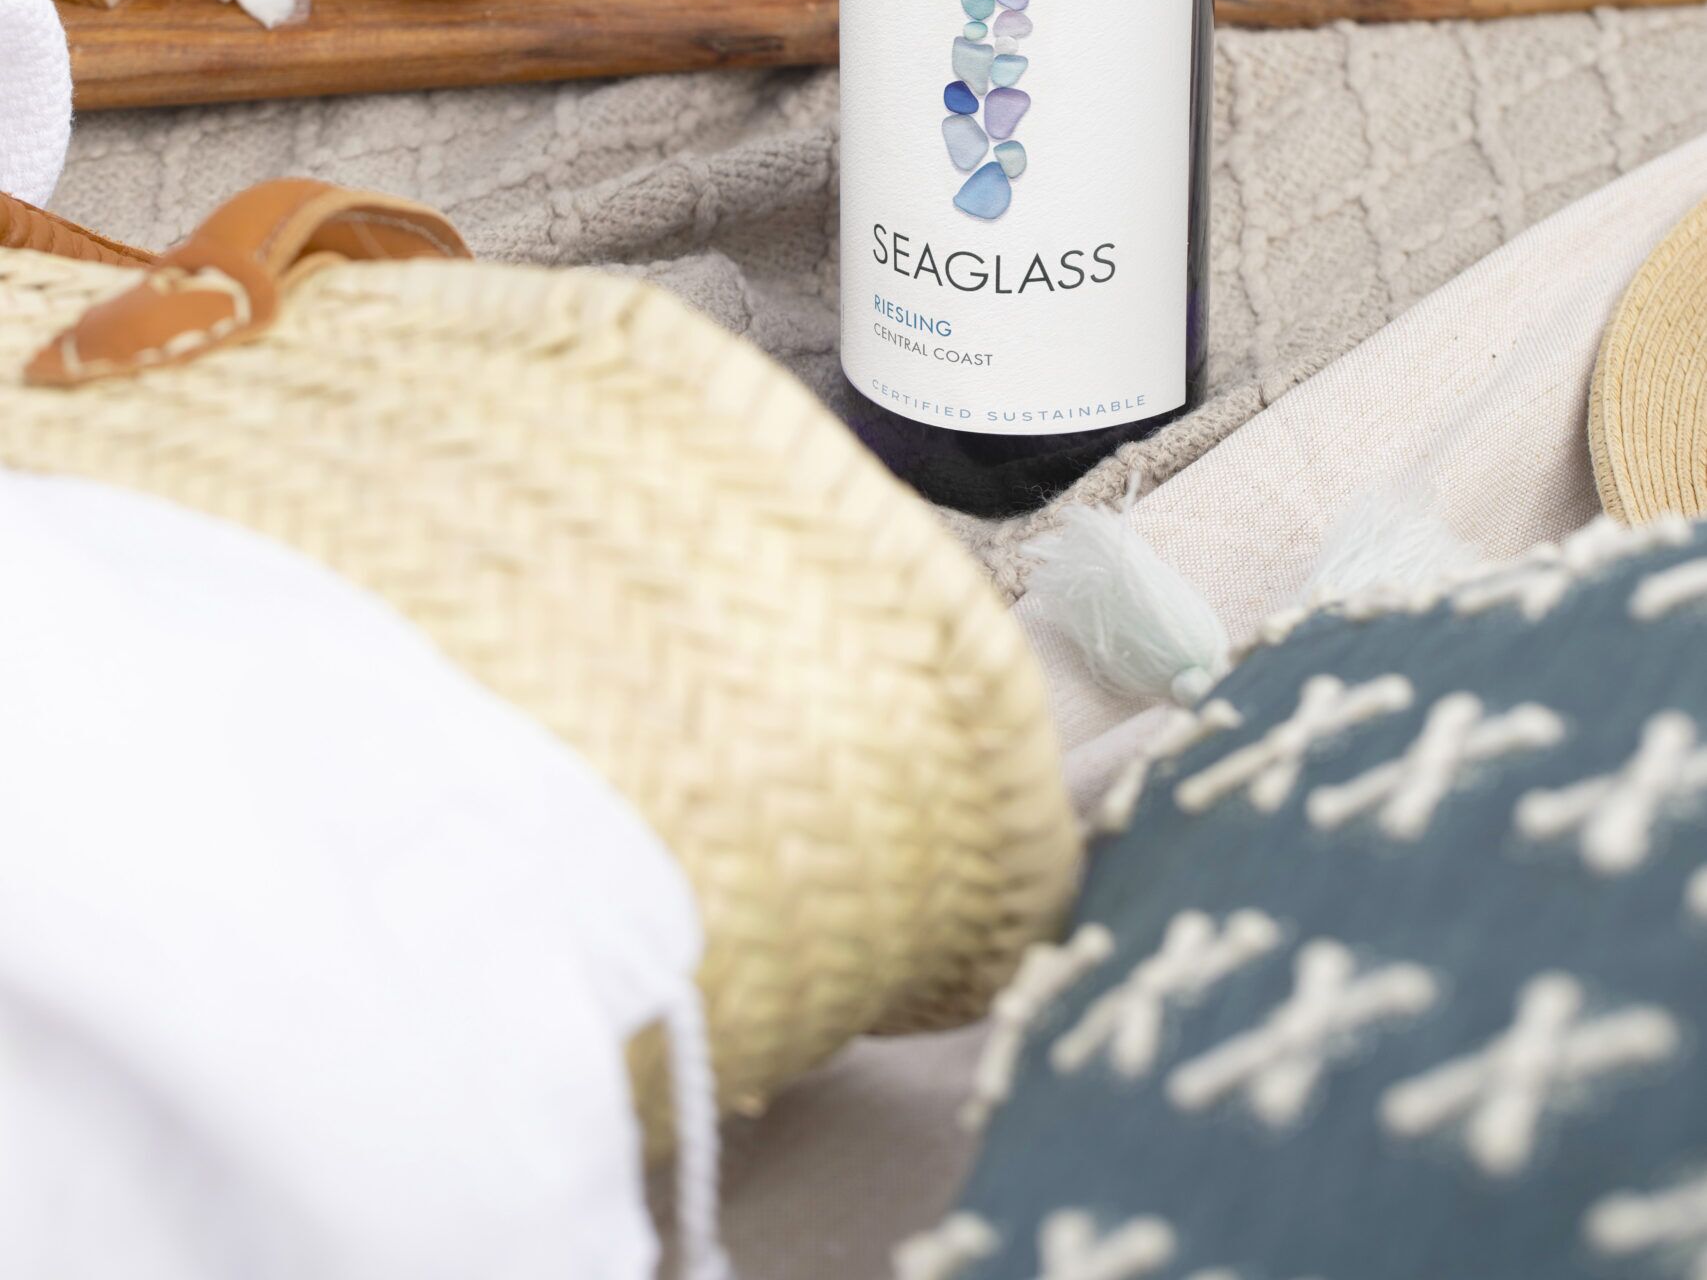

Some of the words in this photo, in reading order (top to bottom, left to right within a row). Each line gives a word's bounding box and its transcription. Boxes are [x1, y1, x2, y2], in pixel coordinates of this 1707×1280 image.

[872, 223, 1117, 294] SEAGLASS
[874, 294, 952, 337] RIESLING
[873, 322, 928, 357] CENTRAL
[933, 347, 993, 367] COAST
[872, 378, 972, 420] CERTIFIED
[987, 394, 1147, 422] SUSTAINABLE
